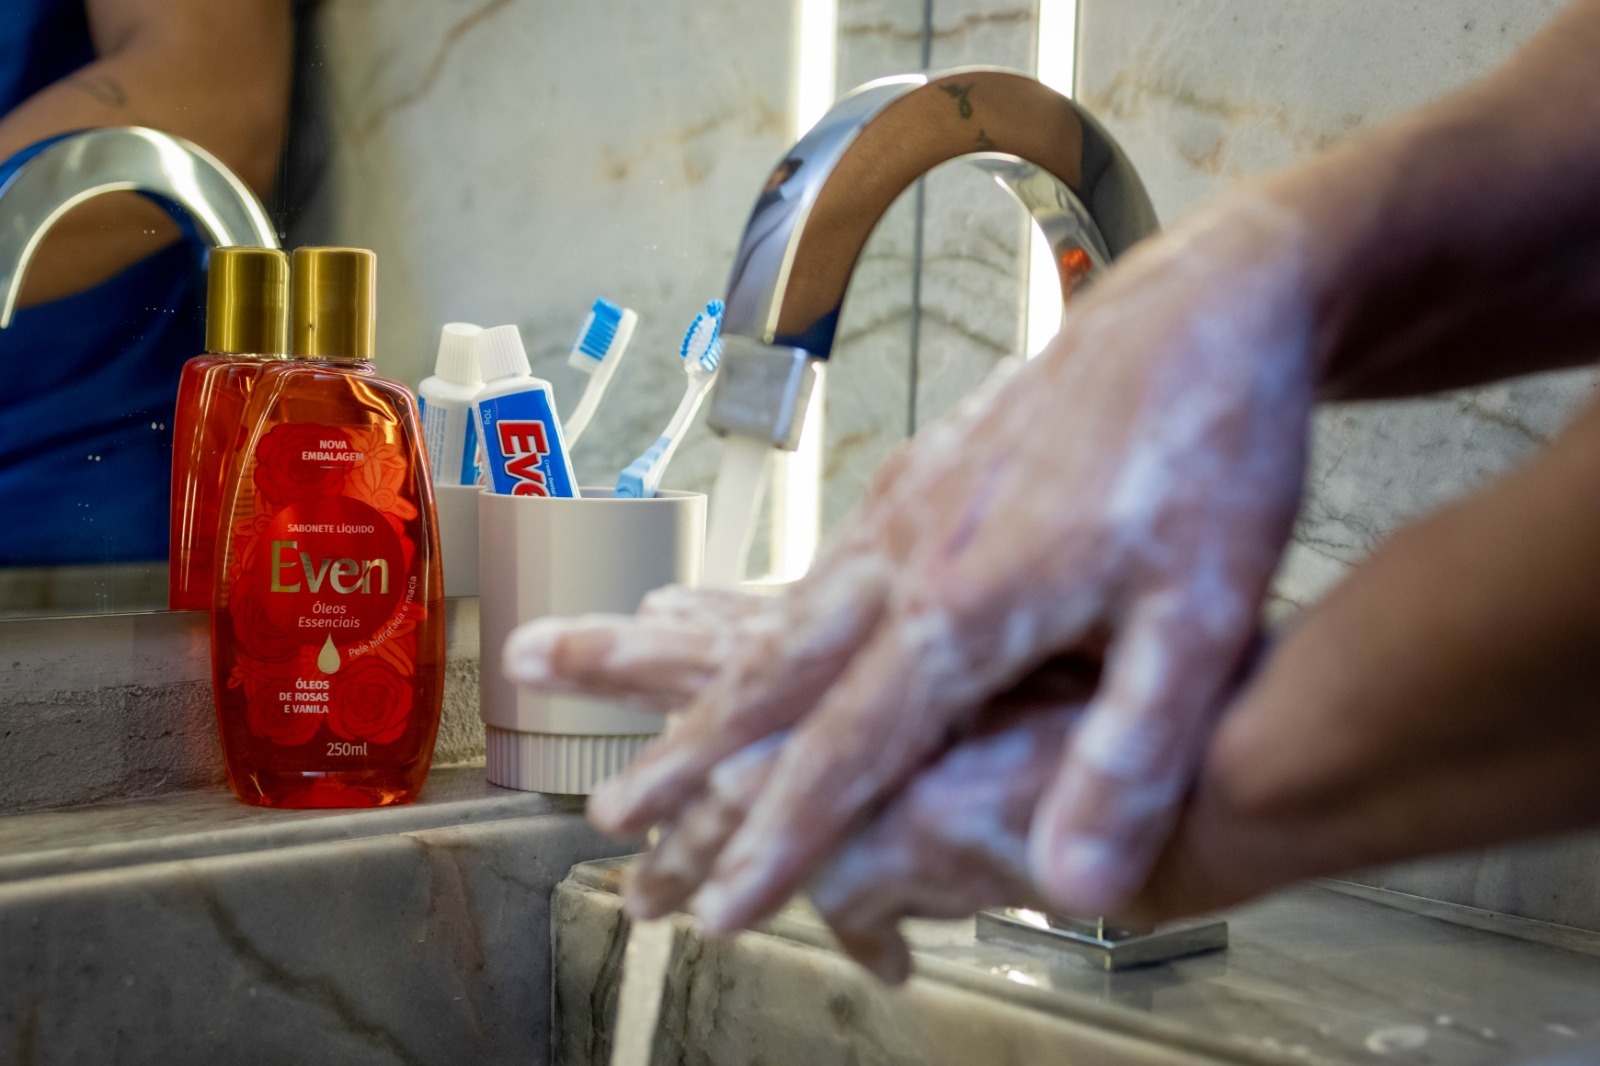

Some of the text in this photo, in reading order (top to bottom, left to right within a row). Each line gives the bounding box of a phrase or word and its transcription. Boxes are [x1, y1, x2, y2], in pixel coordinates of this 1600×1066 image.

[483, 408, 491, 425] 70g
[319, 439, 348, 449] NOVA
[301, 451, 364, 462] EMBALAGEM
[287, 522, 375, 534] SABONETE LÍQUIDO
[270, 540, 389, 594] Even
[312, 600, 347, 614] Óleos
[298, 616, 361, 629] Essenciais
[348, 642, 369, 657] Pele
[370, 614, 405, 649] hidratada
[405, 575, 418, 604] macia
[295, 677, 330, 690] ÓLEOS
[279, 692, 330, 702] DE ROSAS
[284, 704, 330, 714] E VANILA
[326, 742, 368, 757] 250ml
